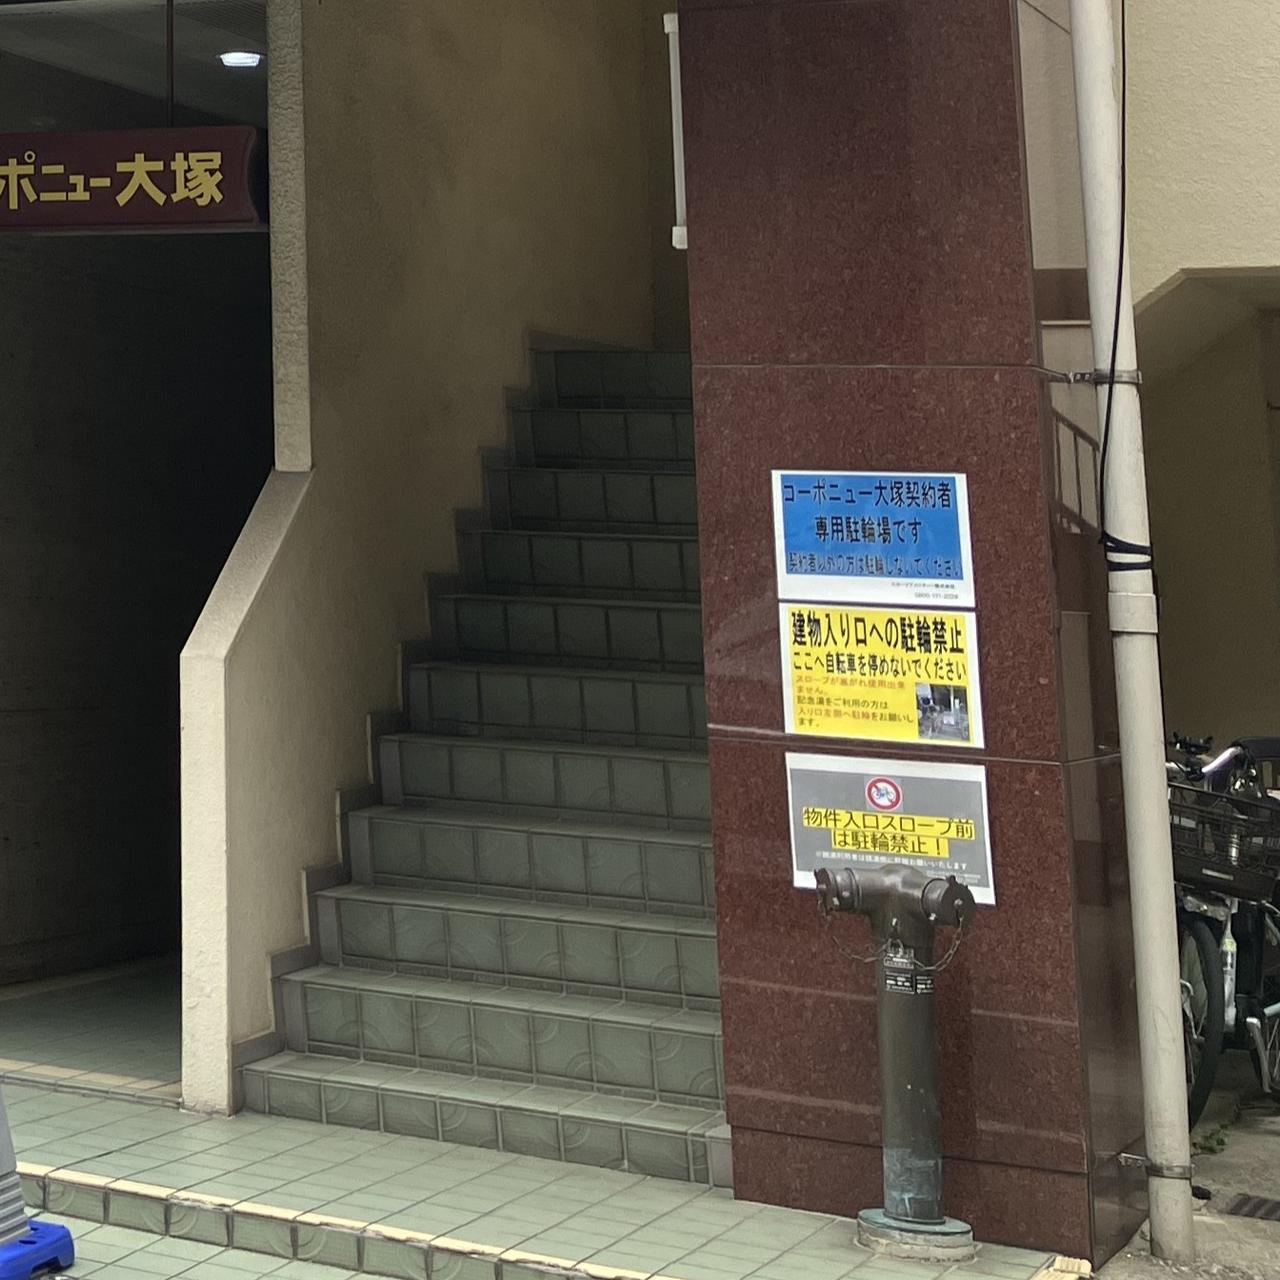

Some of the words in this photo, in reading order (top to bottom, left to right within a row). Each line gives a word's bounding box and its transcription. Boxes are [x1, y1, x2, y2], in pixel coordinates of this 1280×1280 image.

[783, 479, 952, 509] コーポニュー大塚契約者
[815, 515, 922, 544] 専用駐輪場です
[791, 609, 965, 655] 建物入り口への駐輪禁止
[793, 650, 968, 682] ここへ自転車を停めないでください
[797, 694, 889, 710] 記念湯をご利用の方は
[803, 807, 974, 839] 物件入口スロープ前
